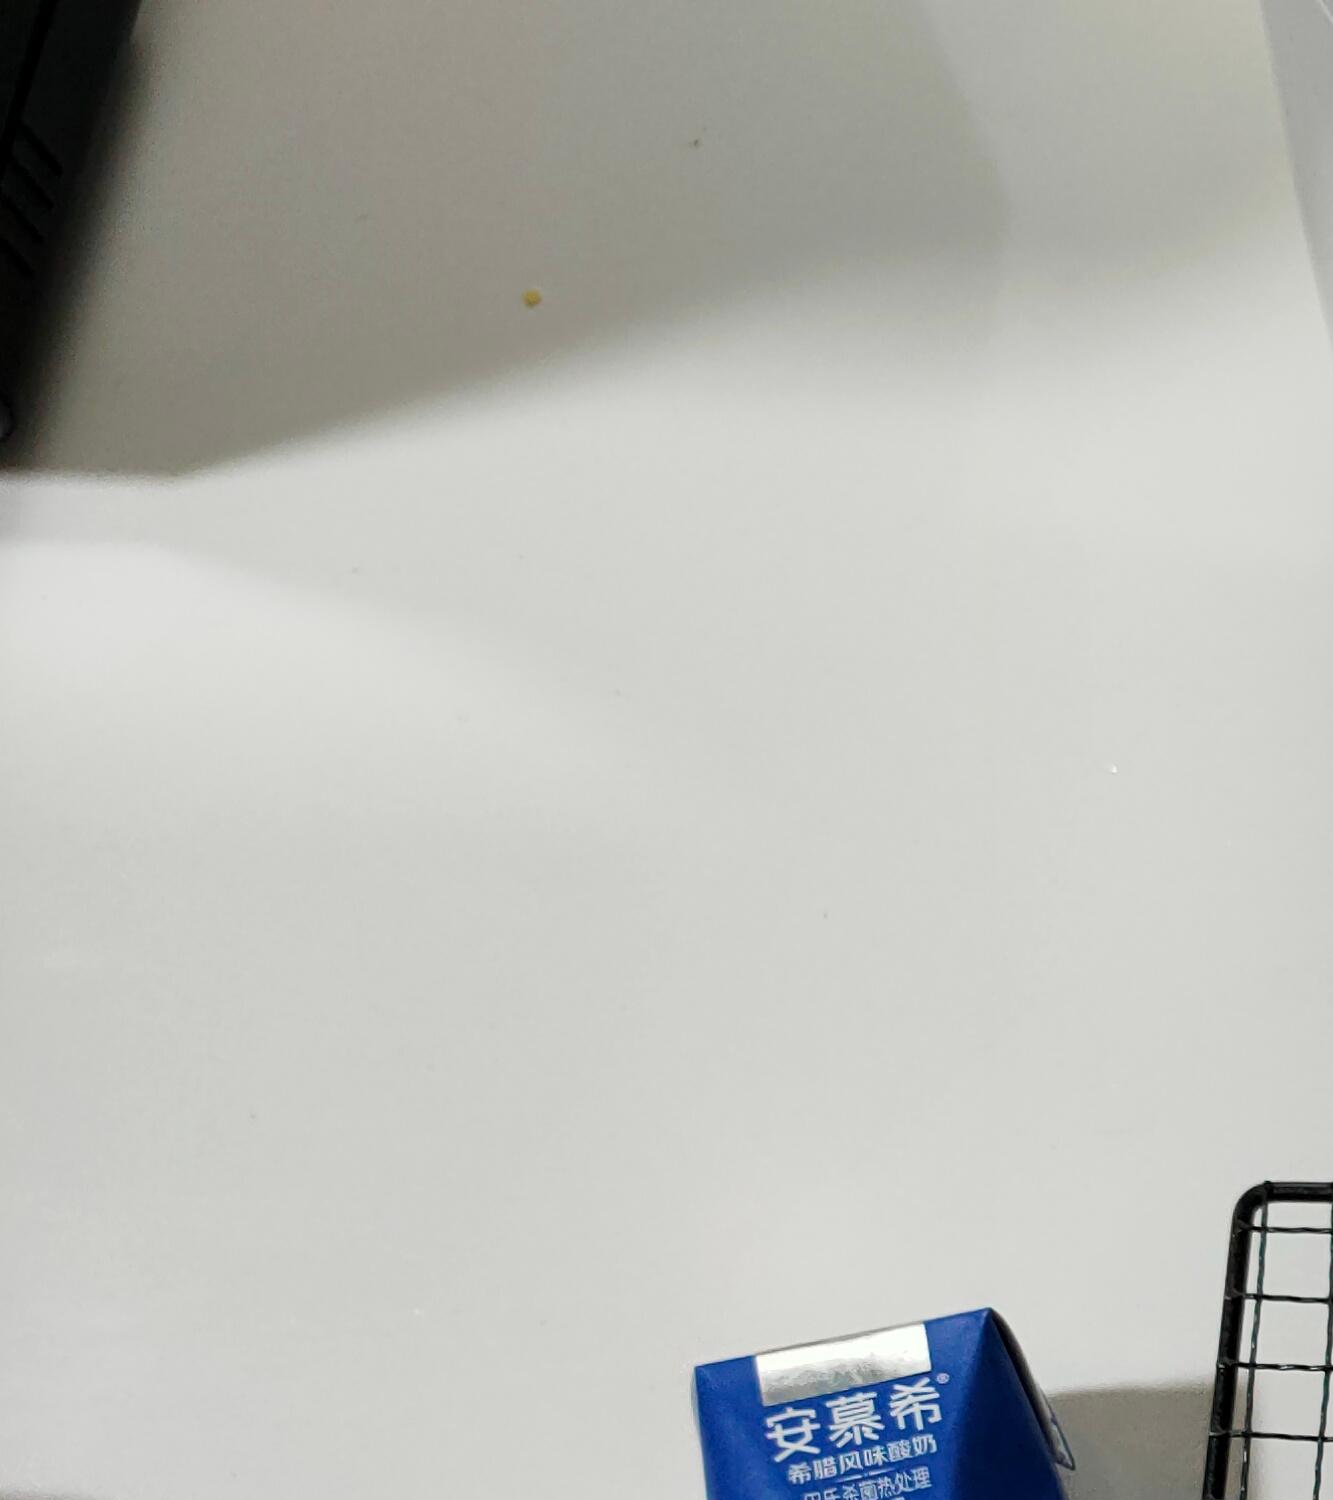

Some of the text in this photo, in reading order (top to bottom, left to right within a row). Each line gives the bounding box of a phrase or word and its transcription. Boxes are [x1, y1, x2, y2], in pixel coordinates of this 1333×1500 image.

[765, 1377, 943, 1464] 安慕希
[787, 1433, 938, 1485] 希腊风味酸奶
